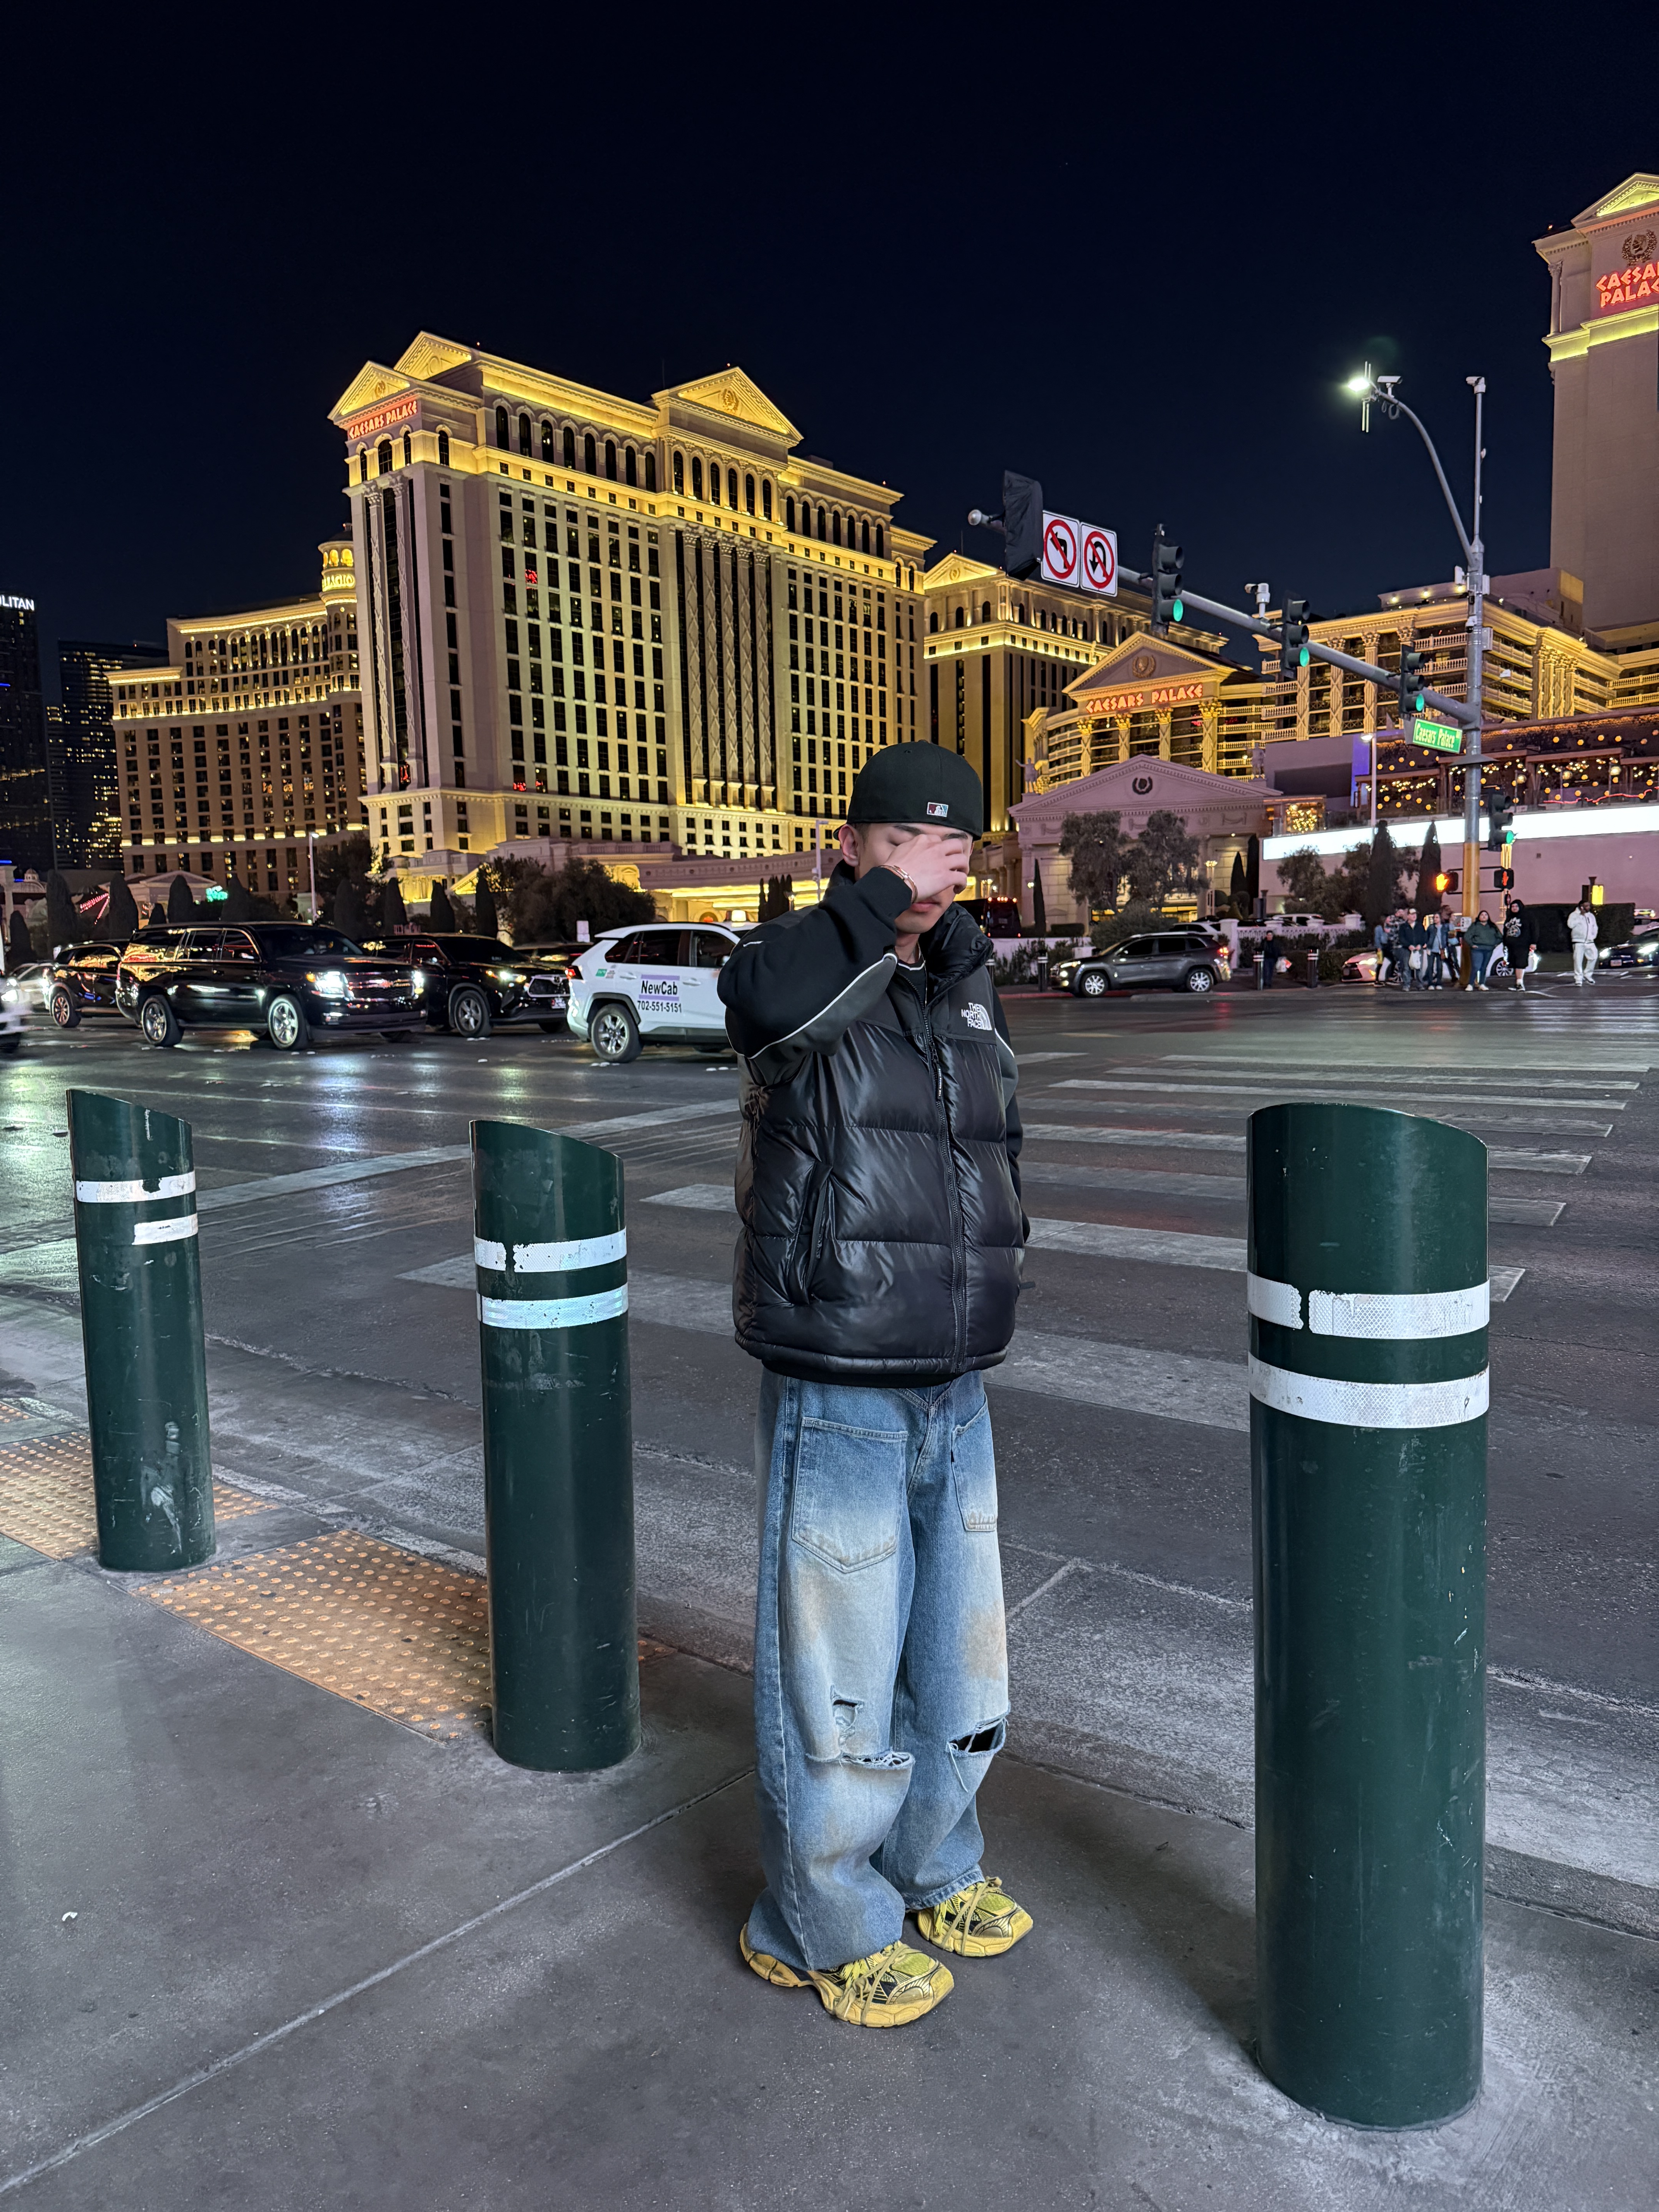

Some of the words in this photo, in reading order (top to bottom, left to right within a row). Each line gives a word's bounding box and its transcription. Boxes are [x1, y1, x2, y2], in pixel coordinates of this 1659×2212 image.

[349, 414, 384, 439] CAESARS
[386, 400, 417, 424] PALACE
[0, 595, 34, 611] LITAN
[1086, 693, 1144, 713] CAESARS
[1151, 684, 1202, 704] PALACE
[1415, 723, 1436, 744] Caesars
[1437, 728, 1455, 748] Palace
[641, 980, 678, 995] NewCab
[637, 1001, 682, 1013] 702-551-5151
[961, 1009, 981, 1020] NORTH
[968, 1002, 981, 1012] THE
[967, 1018, 982, 1029] FACE
